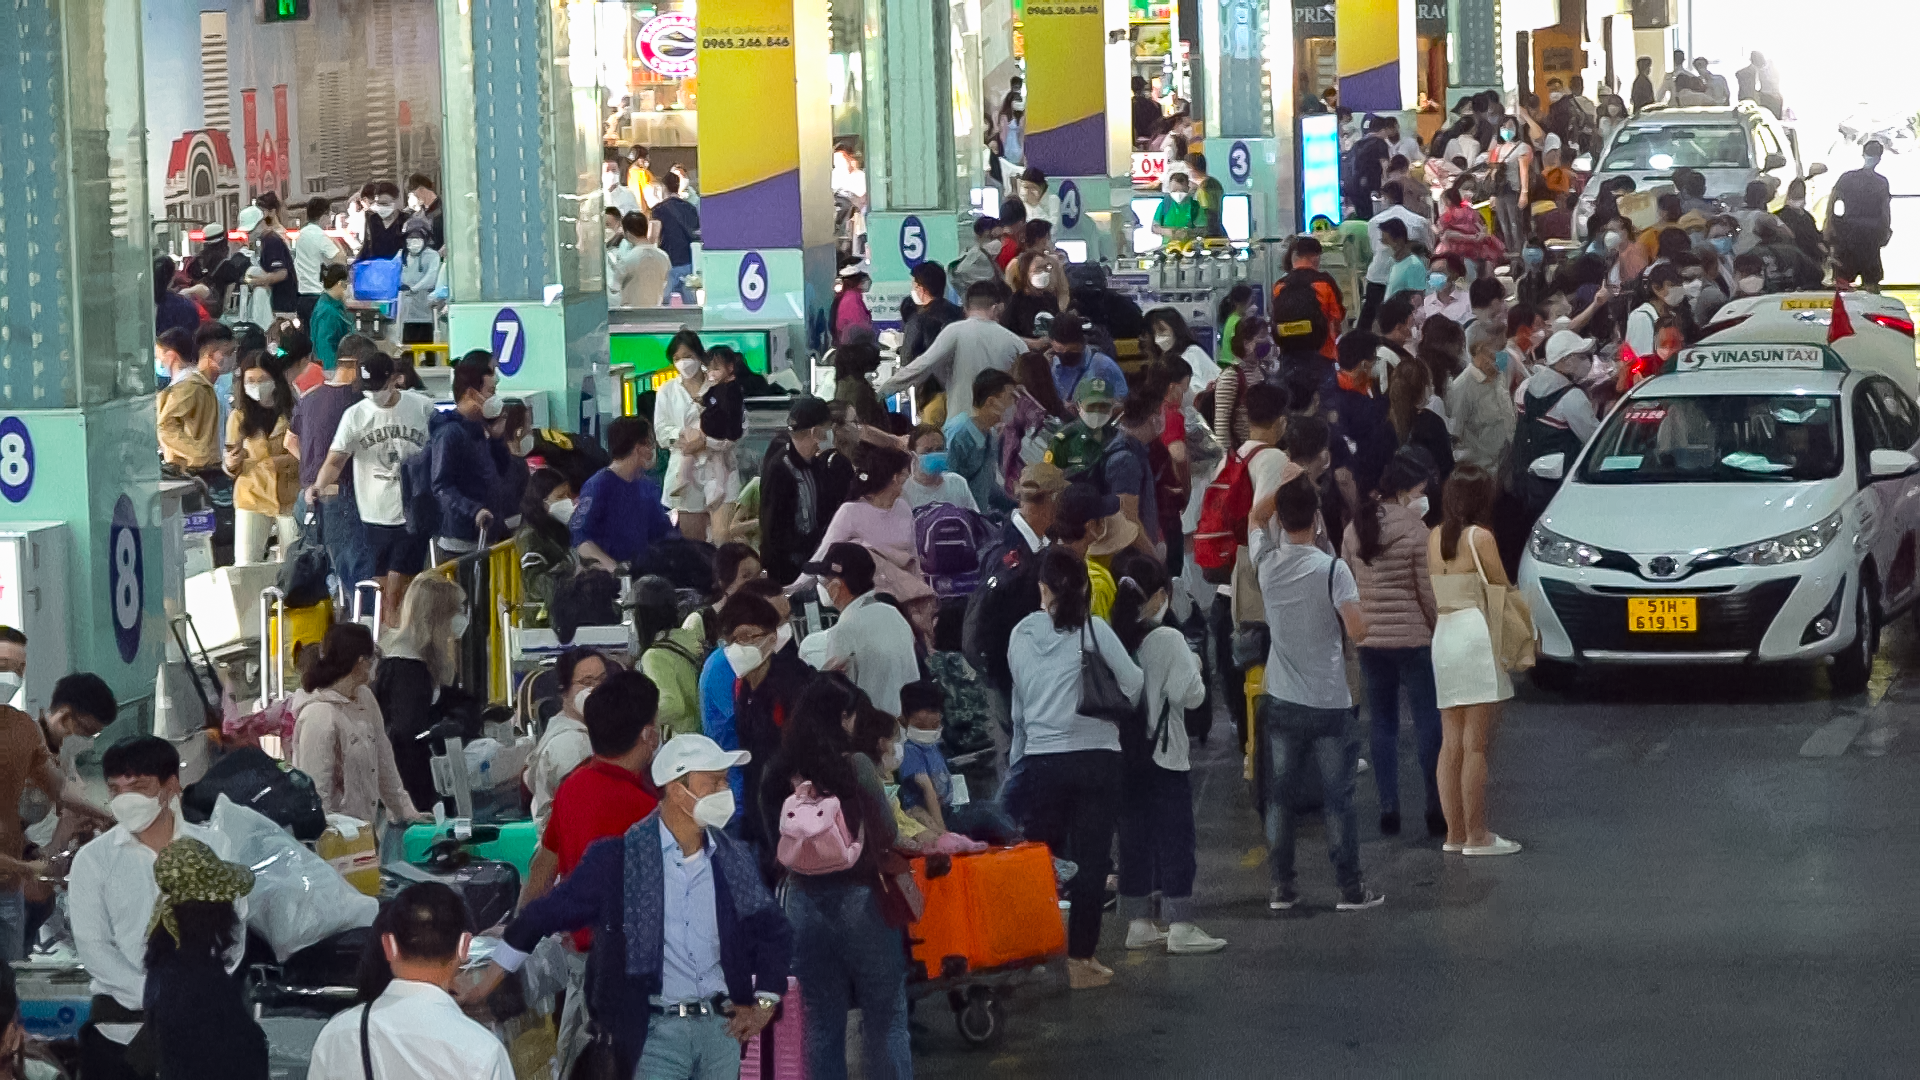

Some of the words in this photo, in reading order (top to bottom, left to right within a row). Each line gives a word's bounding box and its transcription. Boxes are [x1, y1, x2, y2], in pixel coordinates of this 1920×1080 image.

[1141, 153, 1165, 173] ÔM
[1231, 148, 1249, 176] 3
[1060, 188, 1078, 219] 4
[903, 226, 924, 260] 5
[740, 262, 765, 300] 6
[495, 320, 519, 363] 7
[1786, 348, 1819, 361] TAXI
[0, 432, 30, 487] 8
[115, 527, 140, 630] 8
[1647, 600, 1677, 613] 51H
